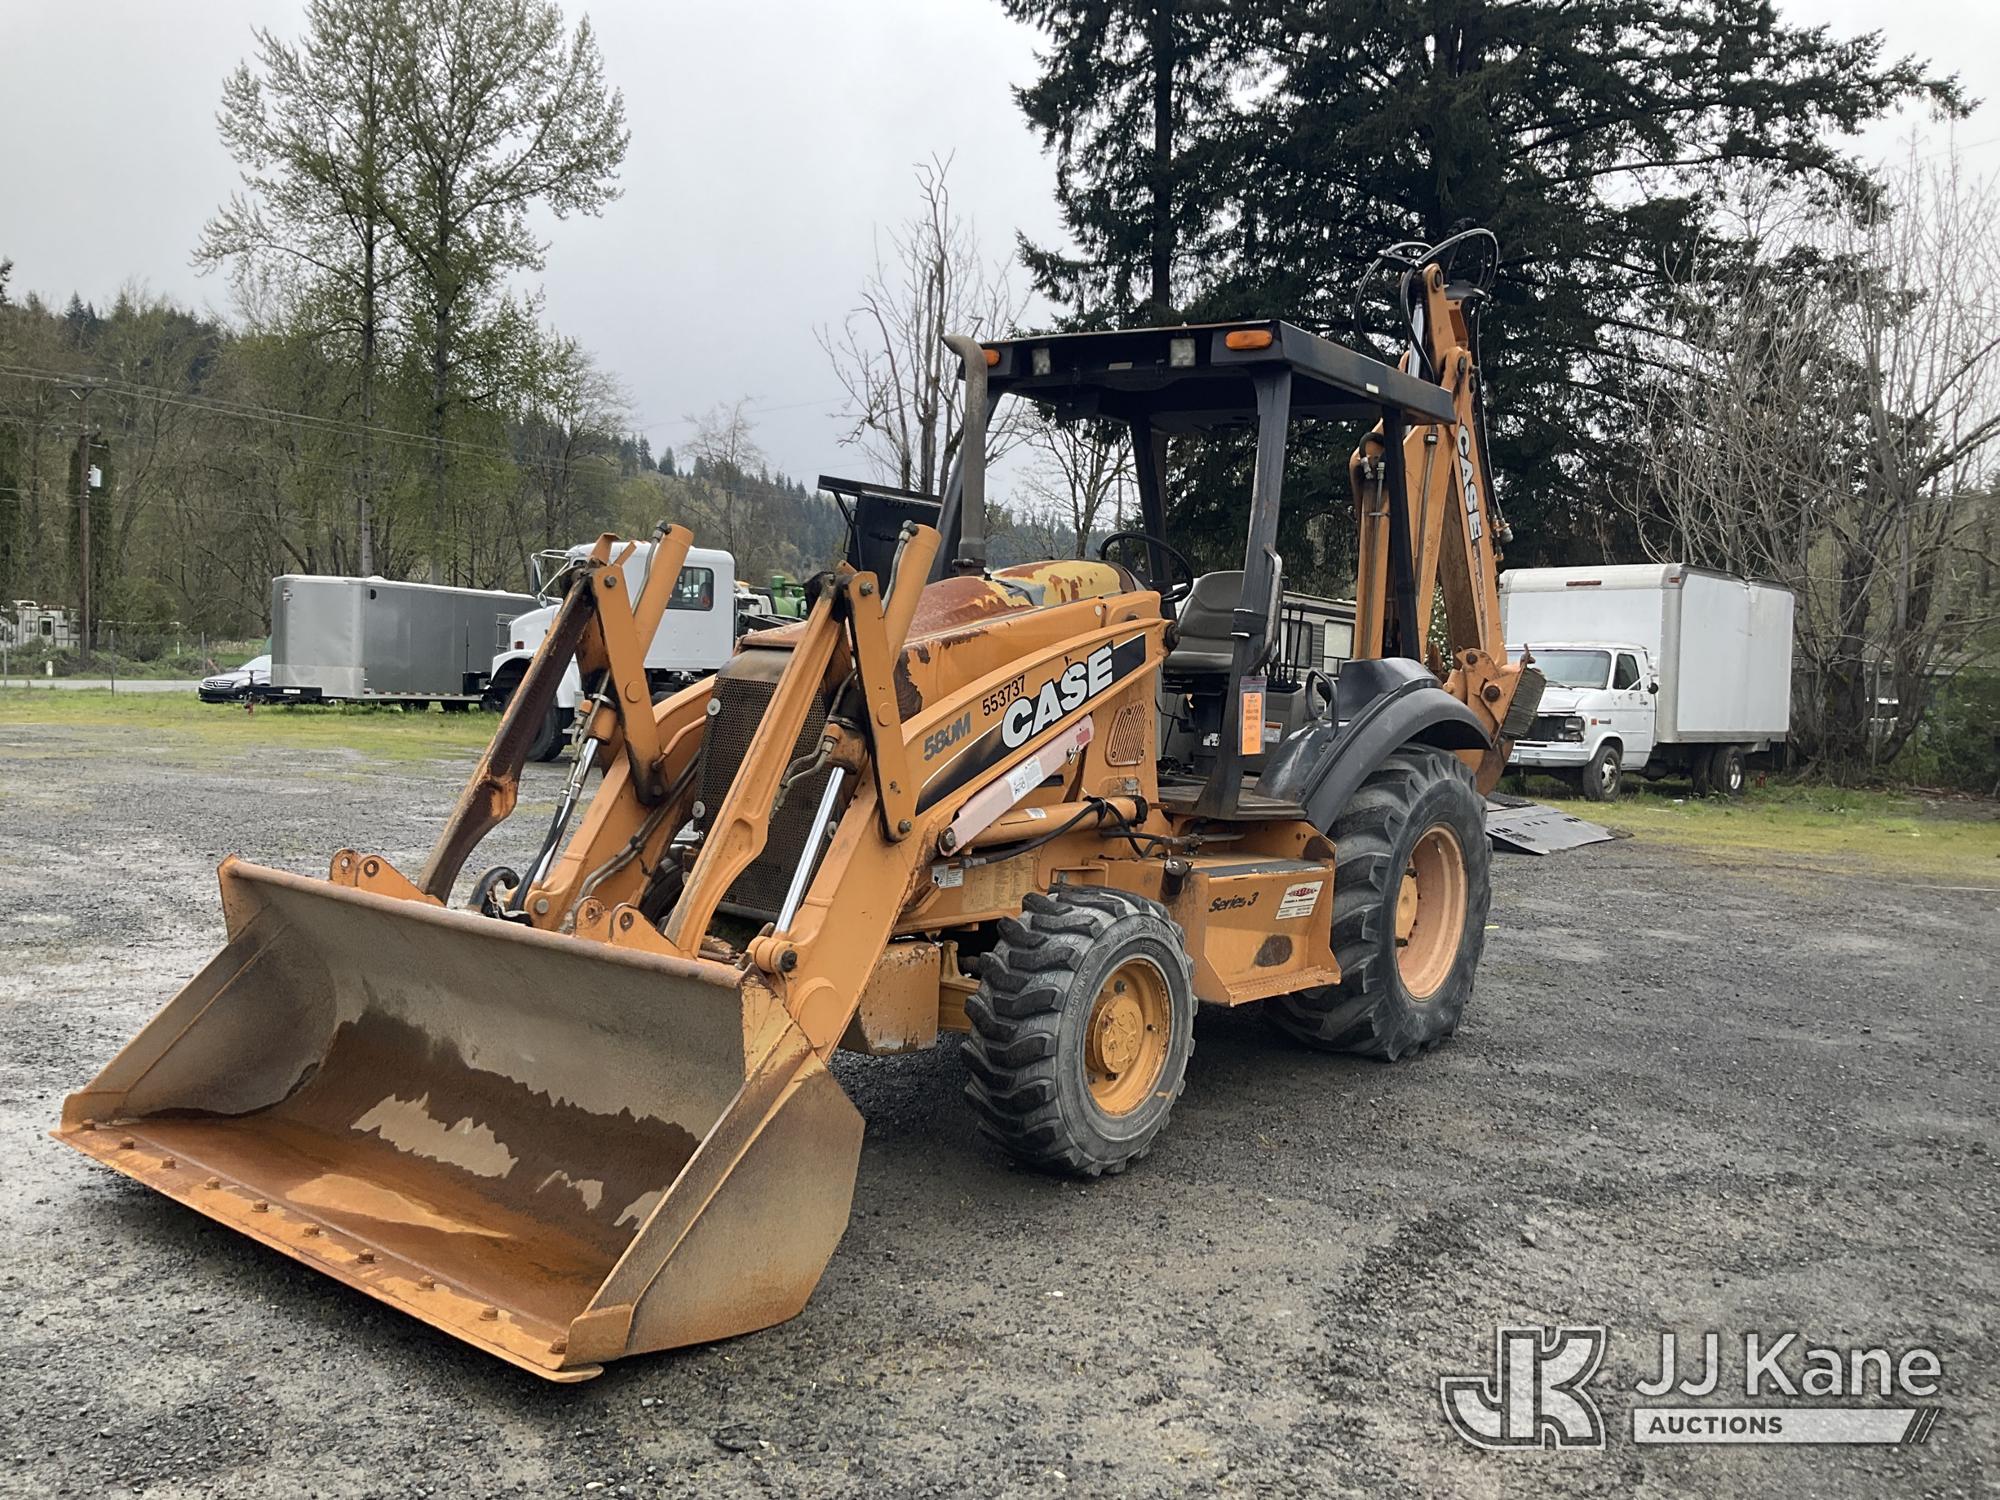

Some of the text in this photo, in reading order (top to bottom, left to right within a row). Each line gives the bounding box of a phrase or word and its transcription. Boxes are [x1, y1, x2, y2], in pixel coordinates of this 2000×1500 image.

[1457, 424, 1482, 540] CASE
[982, 675, 1026, 717] 553737
[1001, 644, 1113, 749] CASE
[923, 711, 971, 761] 580M
[1208, 891, 1259, 912] Series 3
